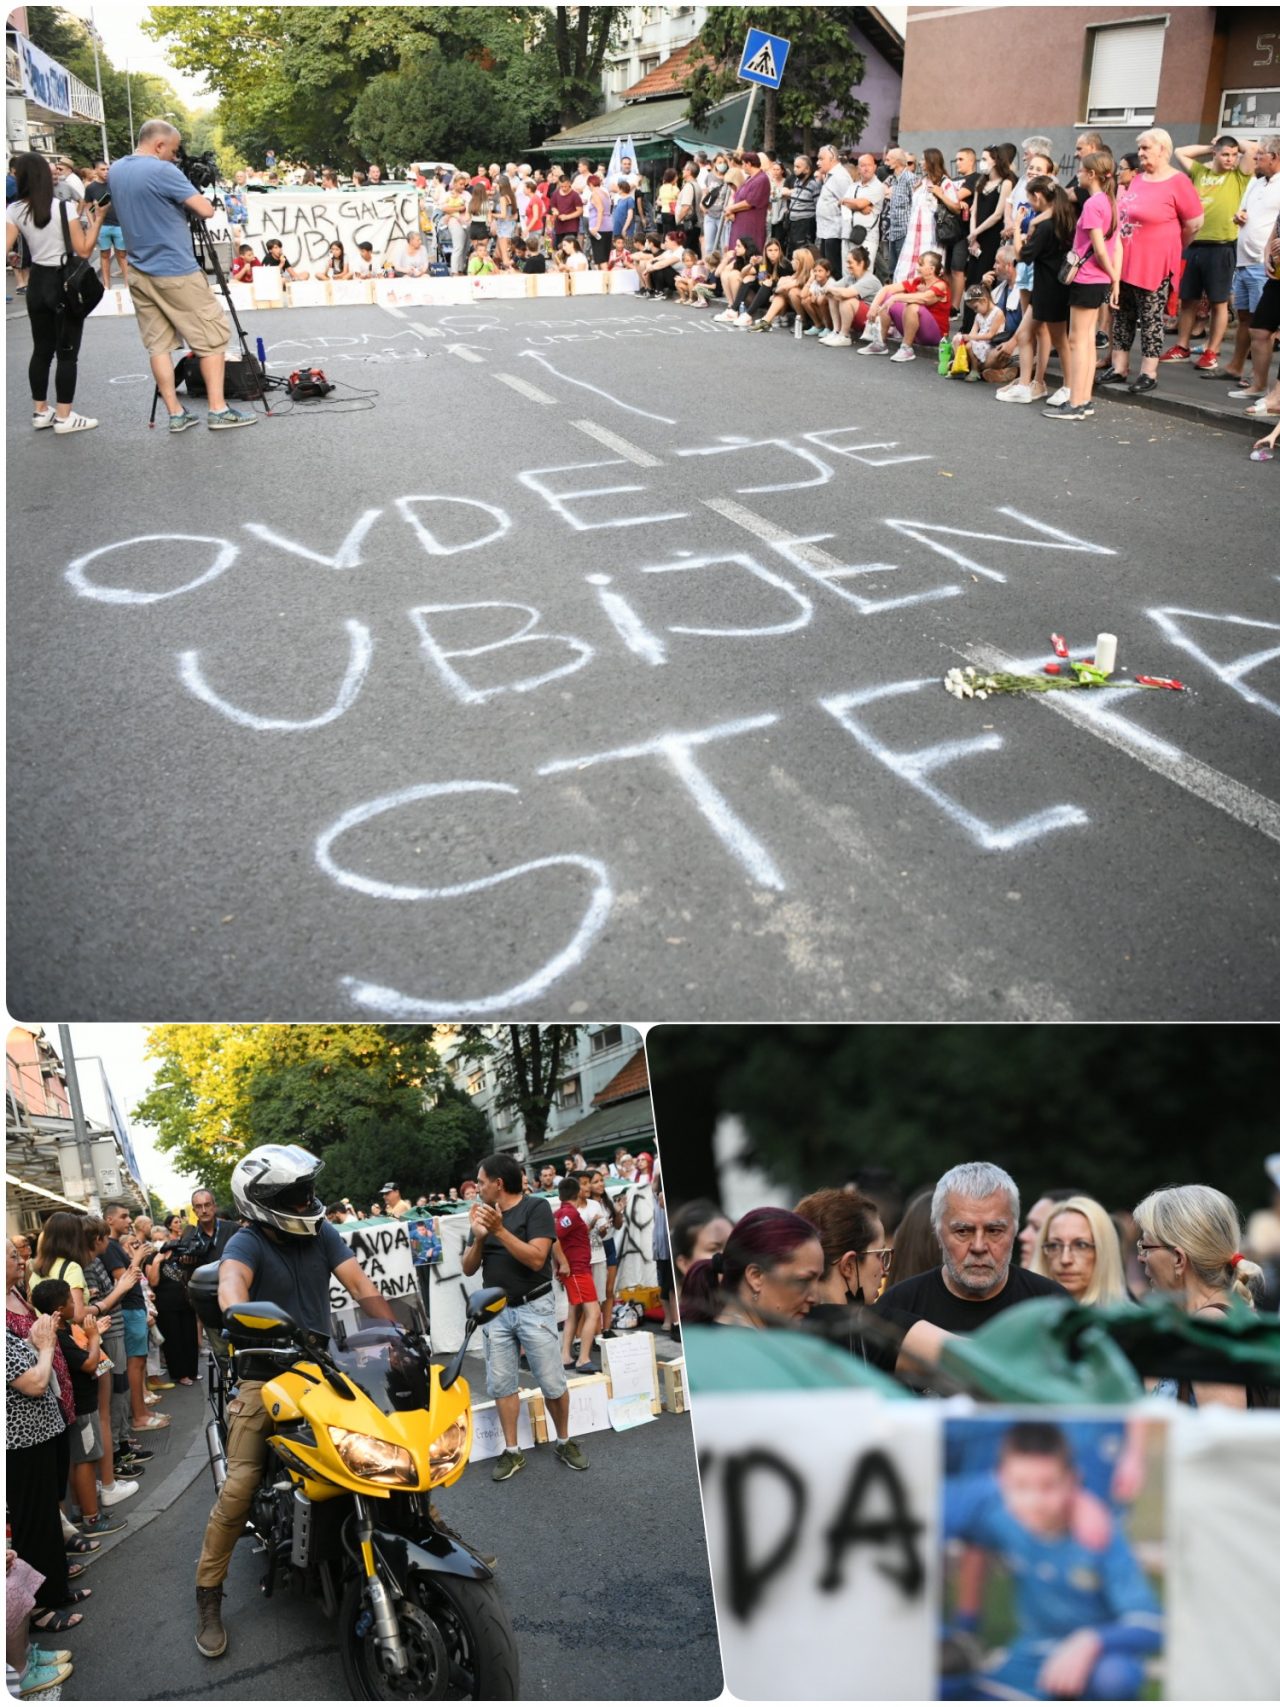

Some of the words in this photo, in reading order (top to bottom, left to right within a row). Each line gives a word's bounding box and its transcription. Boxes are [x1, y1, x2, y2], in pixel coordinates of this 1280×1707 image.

[242, 203, 334, 238] LAZAR
[64, 459, 692, 604] OVDE
[676, 426, 933, 494] JE
